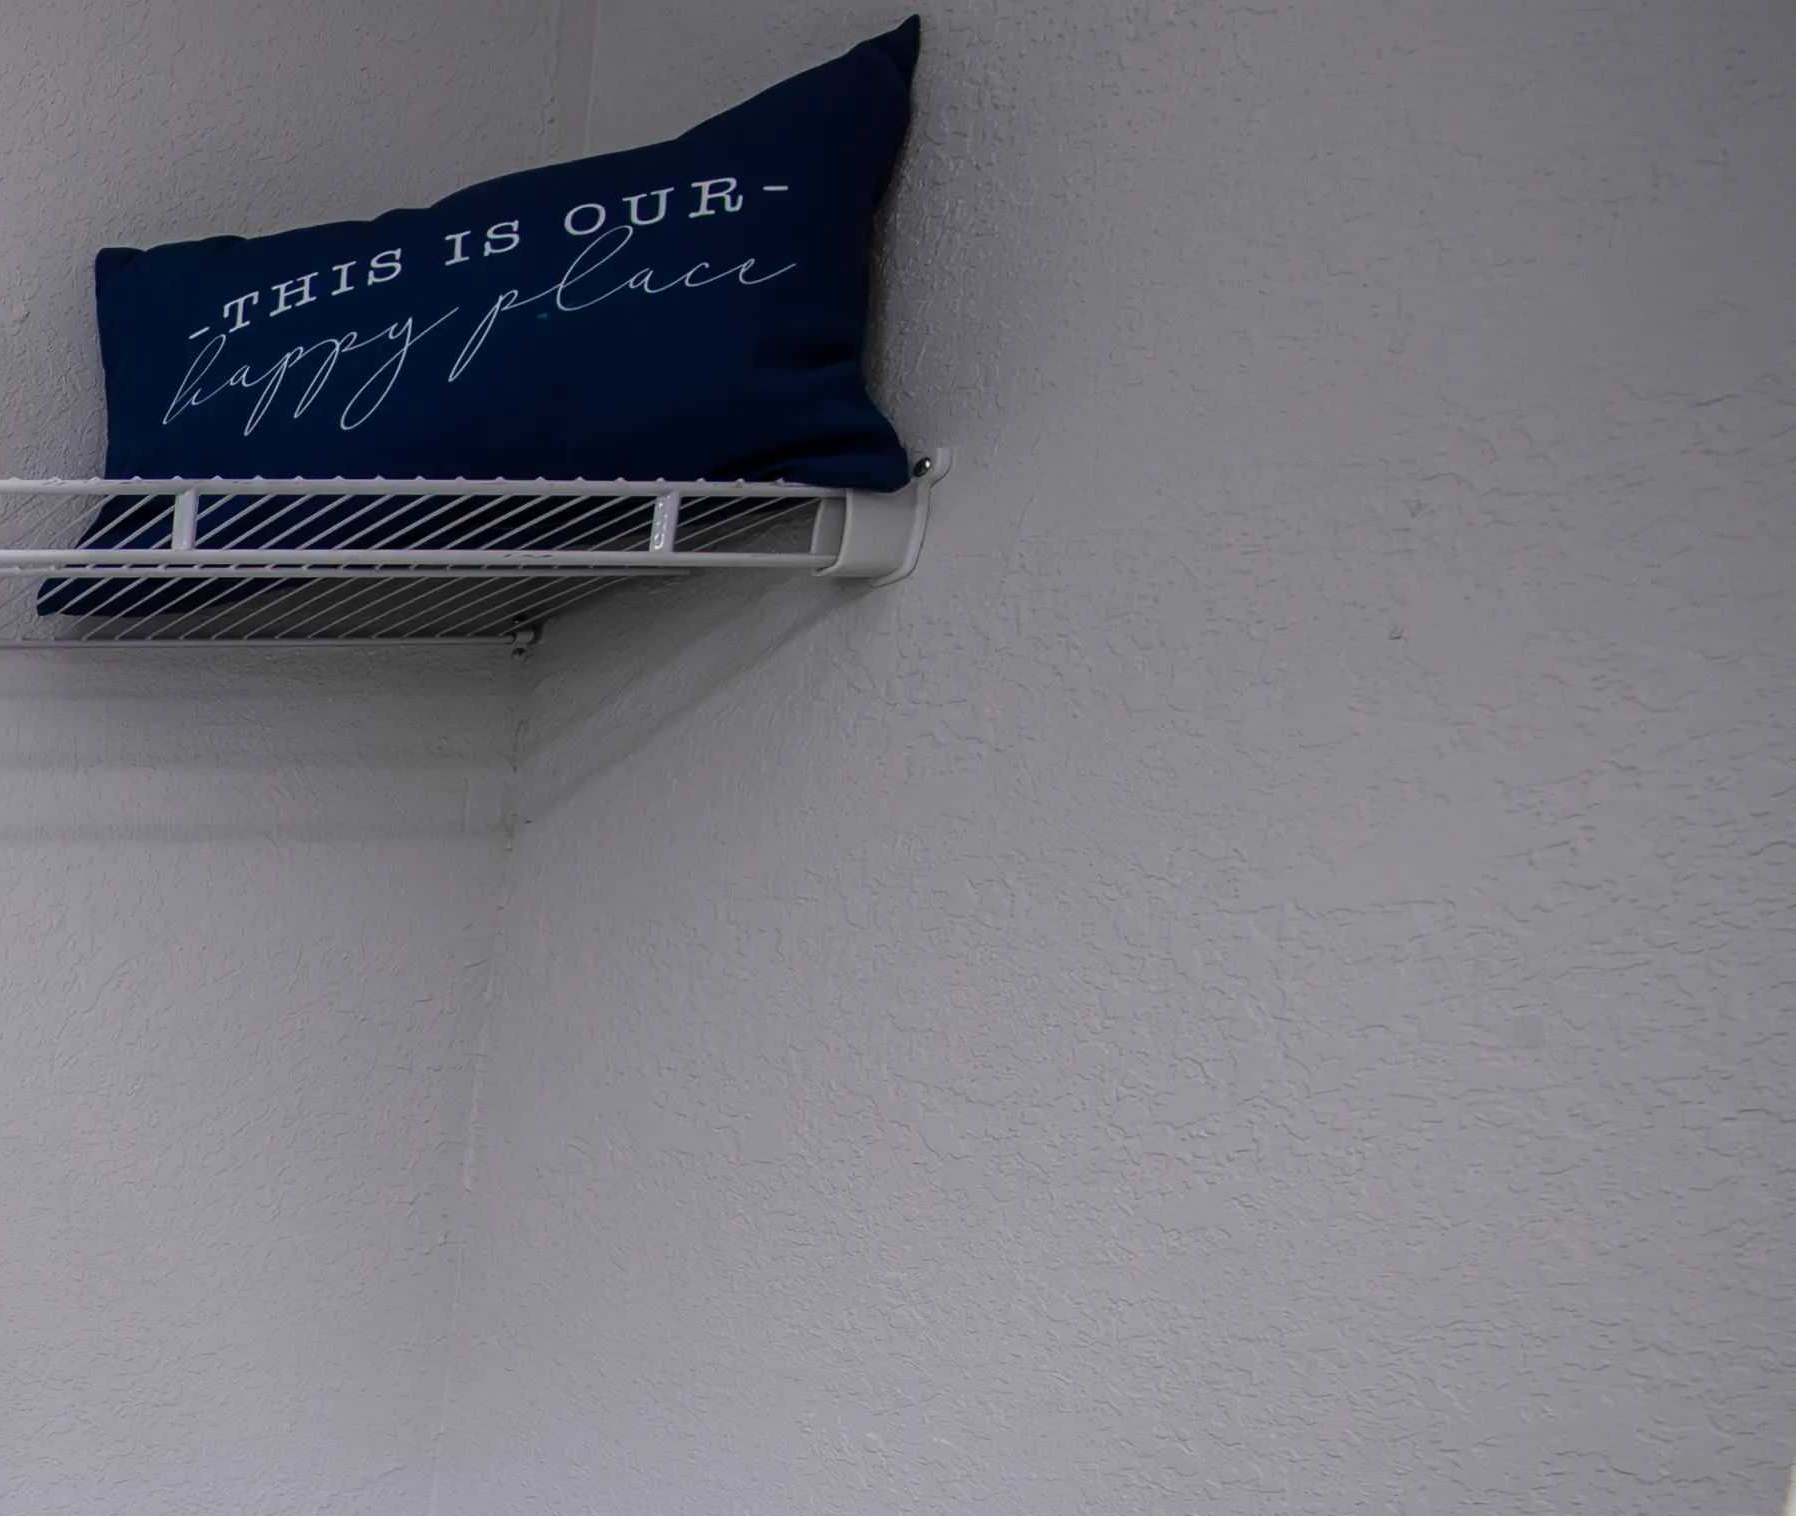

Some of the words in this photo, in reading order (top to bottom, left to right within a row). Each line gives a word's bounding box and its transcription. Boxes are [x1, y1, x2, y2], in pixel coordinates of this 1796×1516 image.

[444, 219, 521, 267] IS
[161, 305, 460, 437] happy
[447, 224, 798, 383] place
